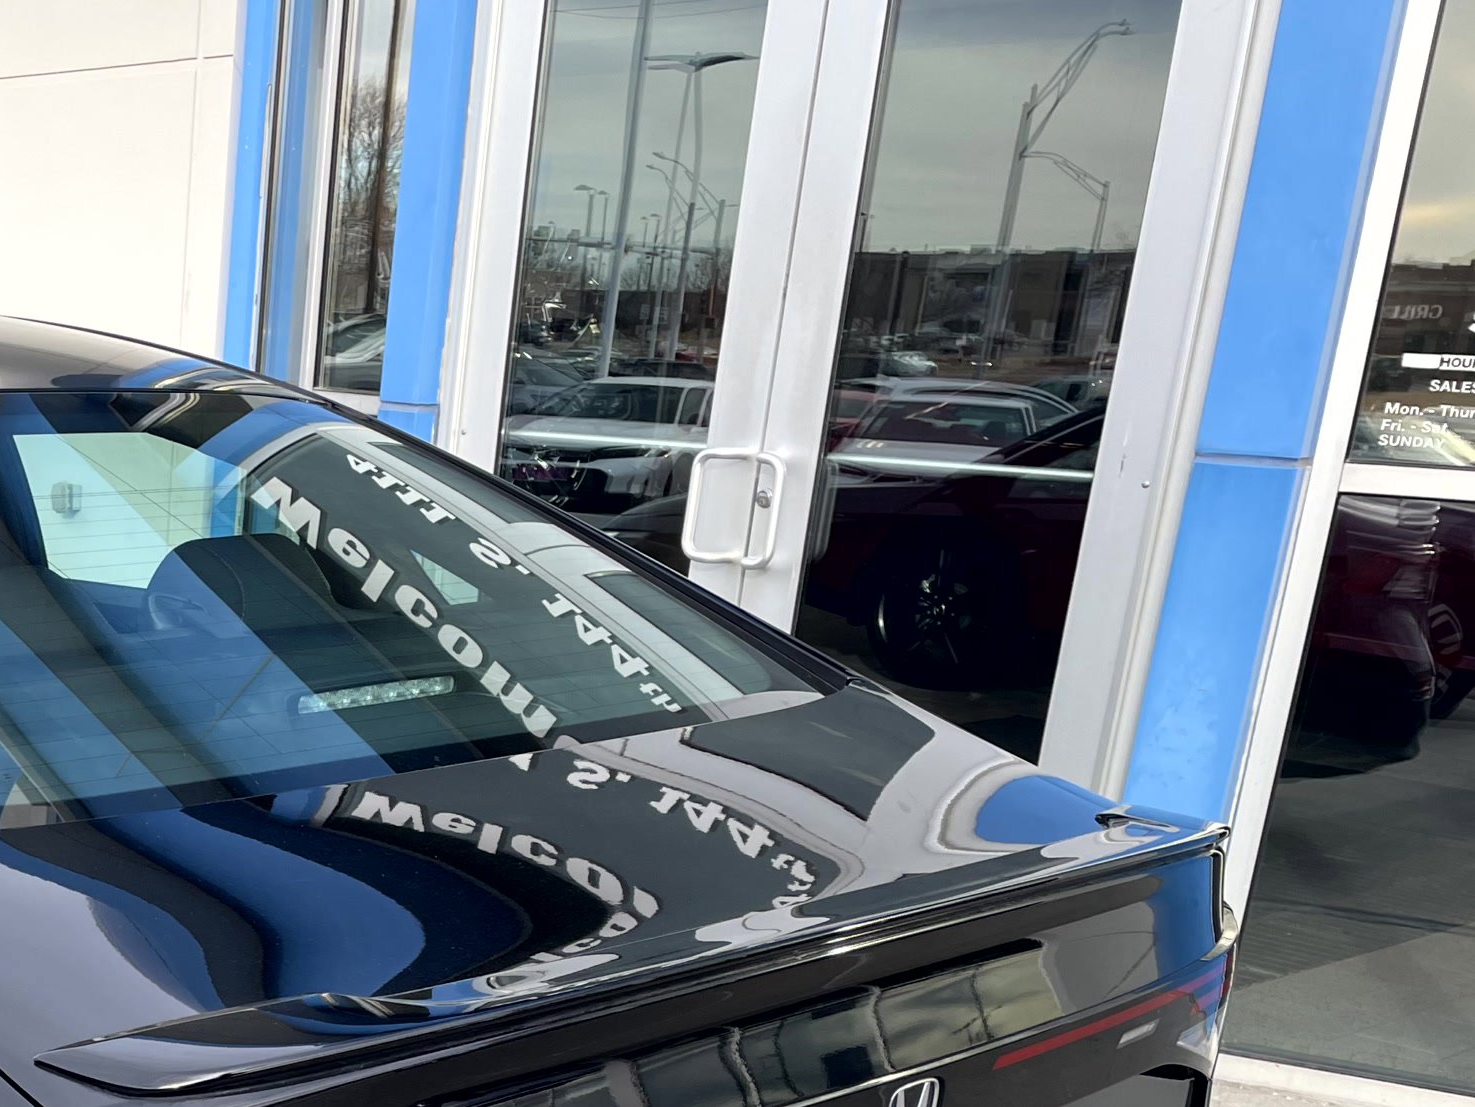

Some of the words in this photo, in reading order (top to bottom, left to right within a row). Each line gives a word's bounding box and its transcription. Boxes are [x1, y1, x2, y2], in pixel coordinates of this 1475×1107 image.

[1439, 357, 1475, 369] HOU
[1384, 401, 1424, 416] Mon.
[1380, 418, 1406, 432] Fri.
[1378, 434, 1446, 449] SUNDAY
